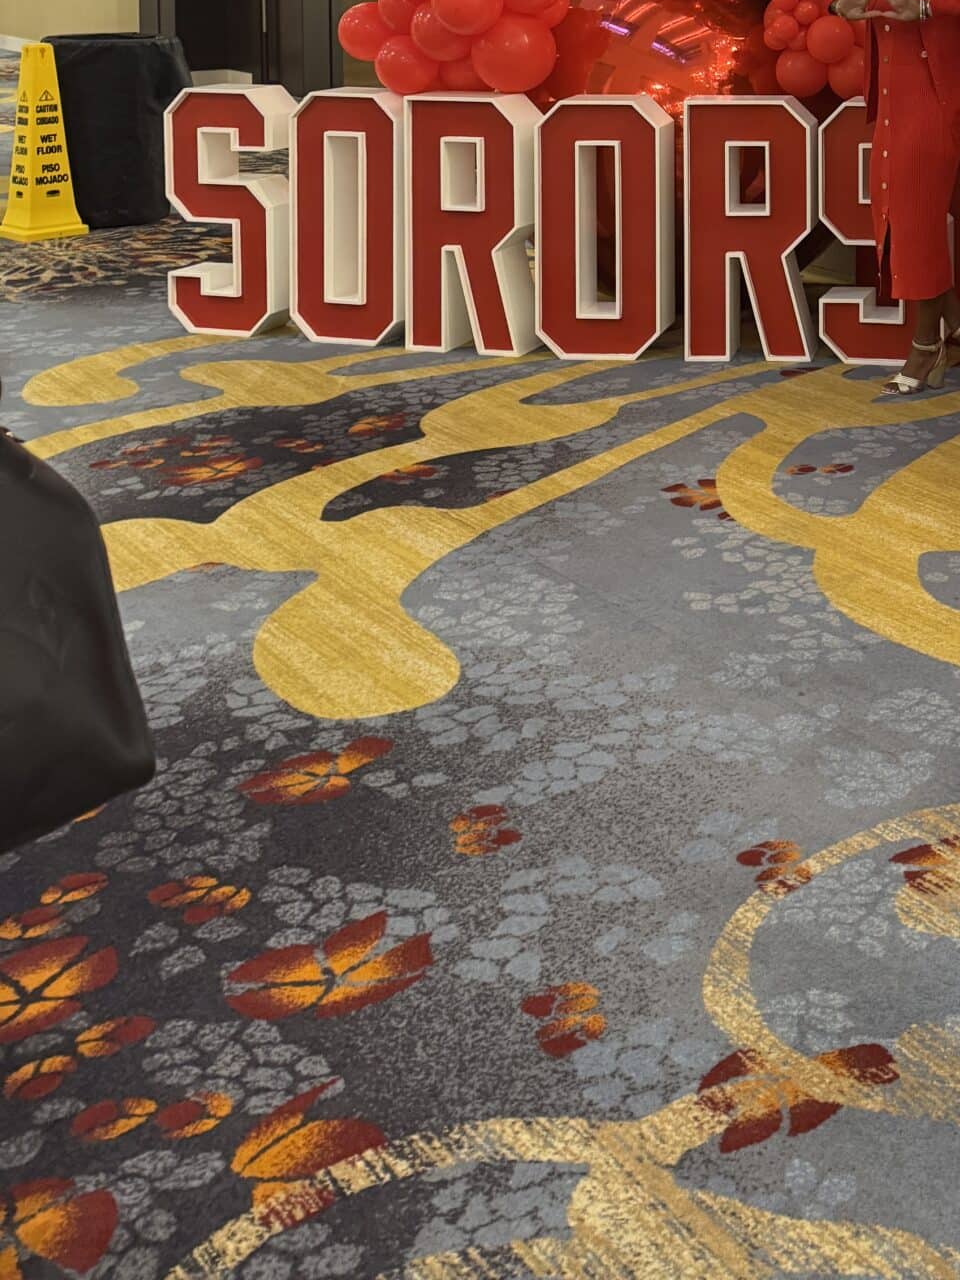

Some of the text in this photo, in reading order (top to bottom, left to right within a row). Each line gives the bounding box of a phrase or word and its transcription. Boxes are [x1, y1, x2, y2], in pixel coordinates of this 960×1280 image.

[36, 104, 58, 113] CAUTION
[40, 134, 57, 144] WET
[37, 145, 62, 155] FLOOR
[42, 163, 60, 174] PISO
[35, 174, 69, 186] MOJADO
